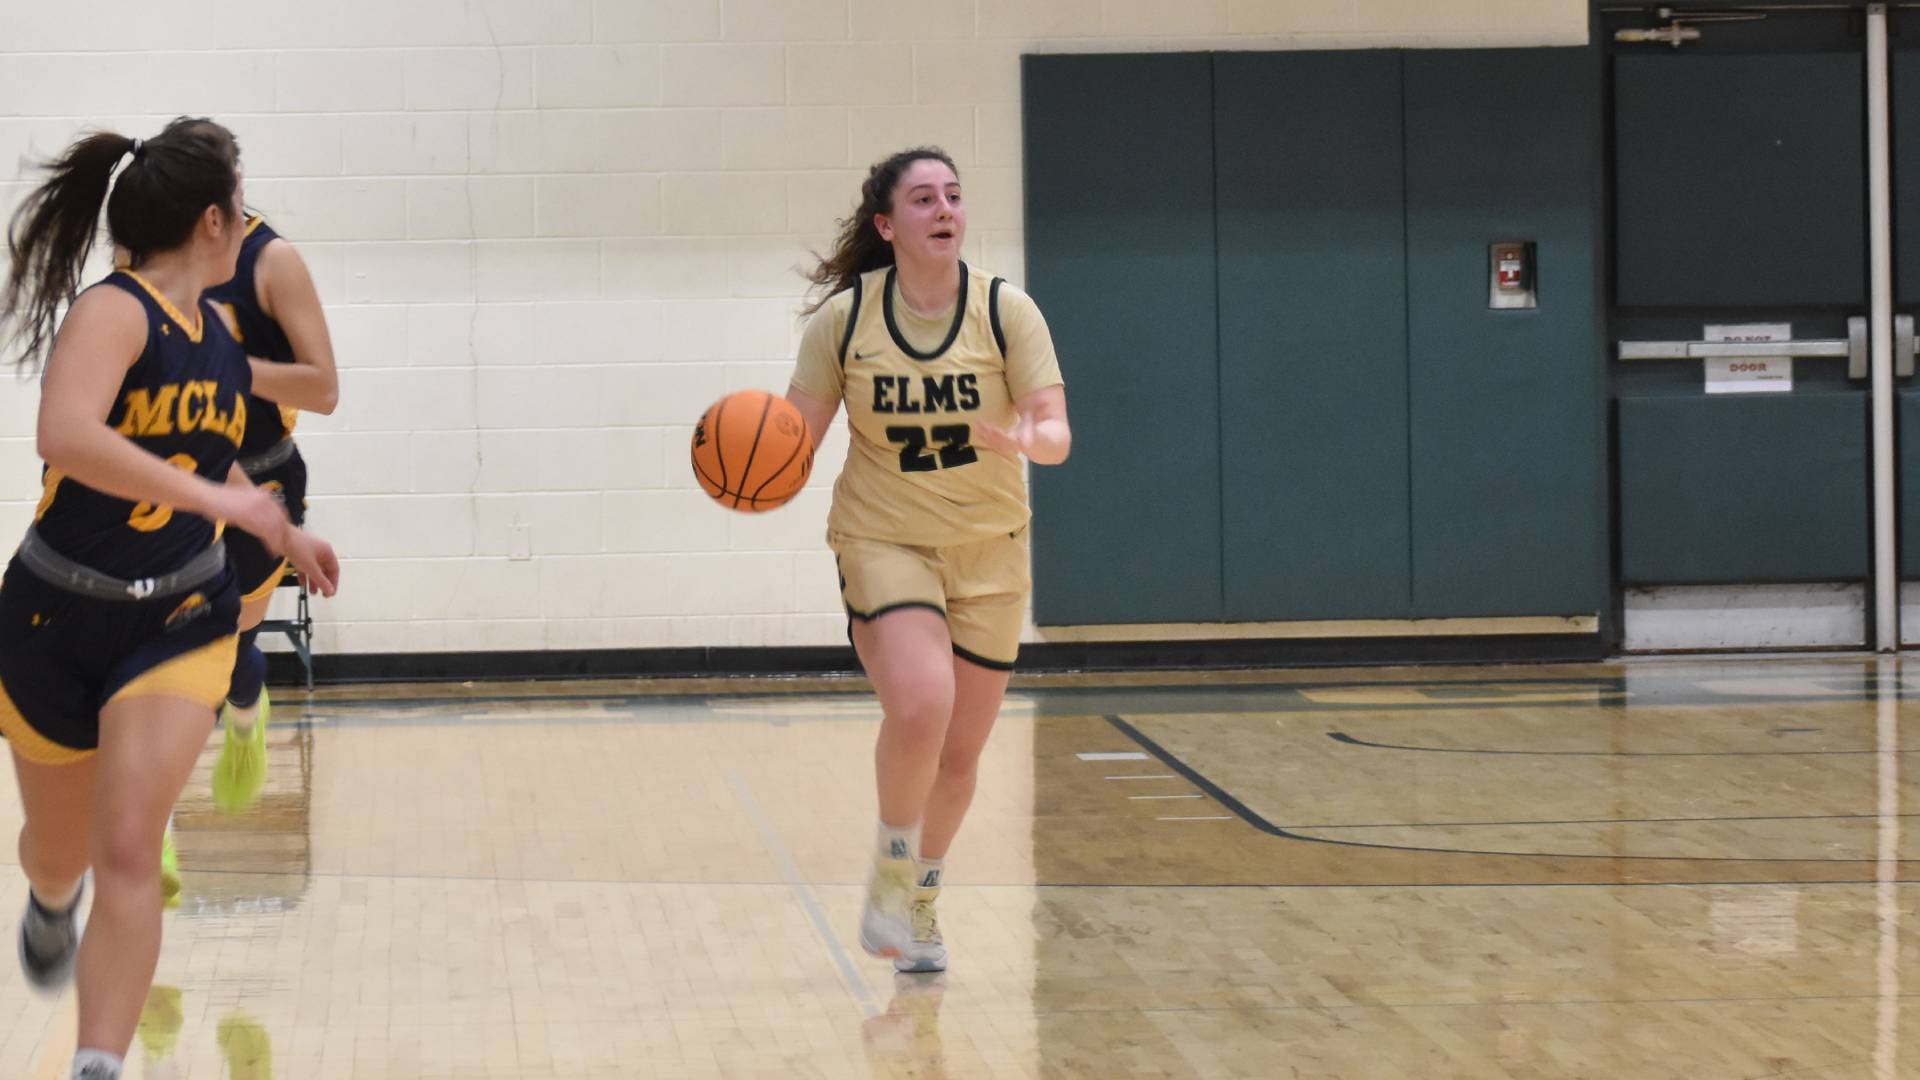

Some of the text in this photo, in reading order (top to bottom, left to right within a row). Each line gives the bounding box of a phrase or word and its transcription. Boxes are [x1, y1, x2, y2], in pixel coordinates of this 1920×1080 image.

[1729, 363, 1767, 372] DOOR
[116, 379, 247, 450] MCLA
[872, 373, 981, 413] ELMS
[885, 424, 978, 473] 22
